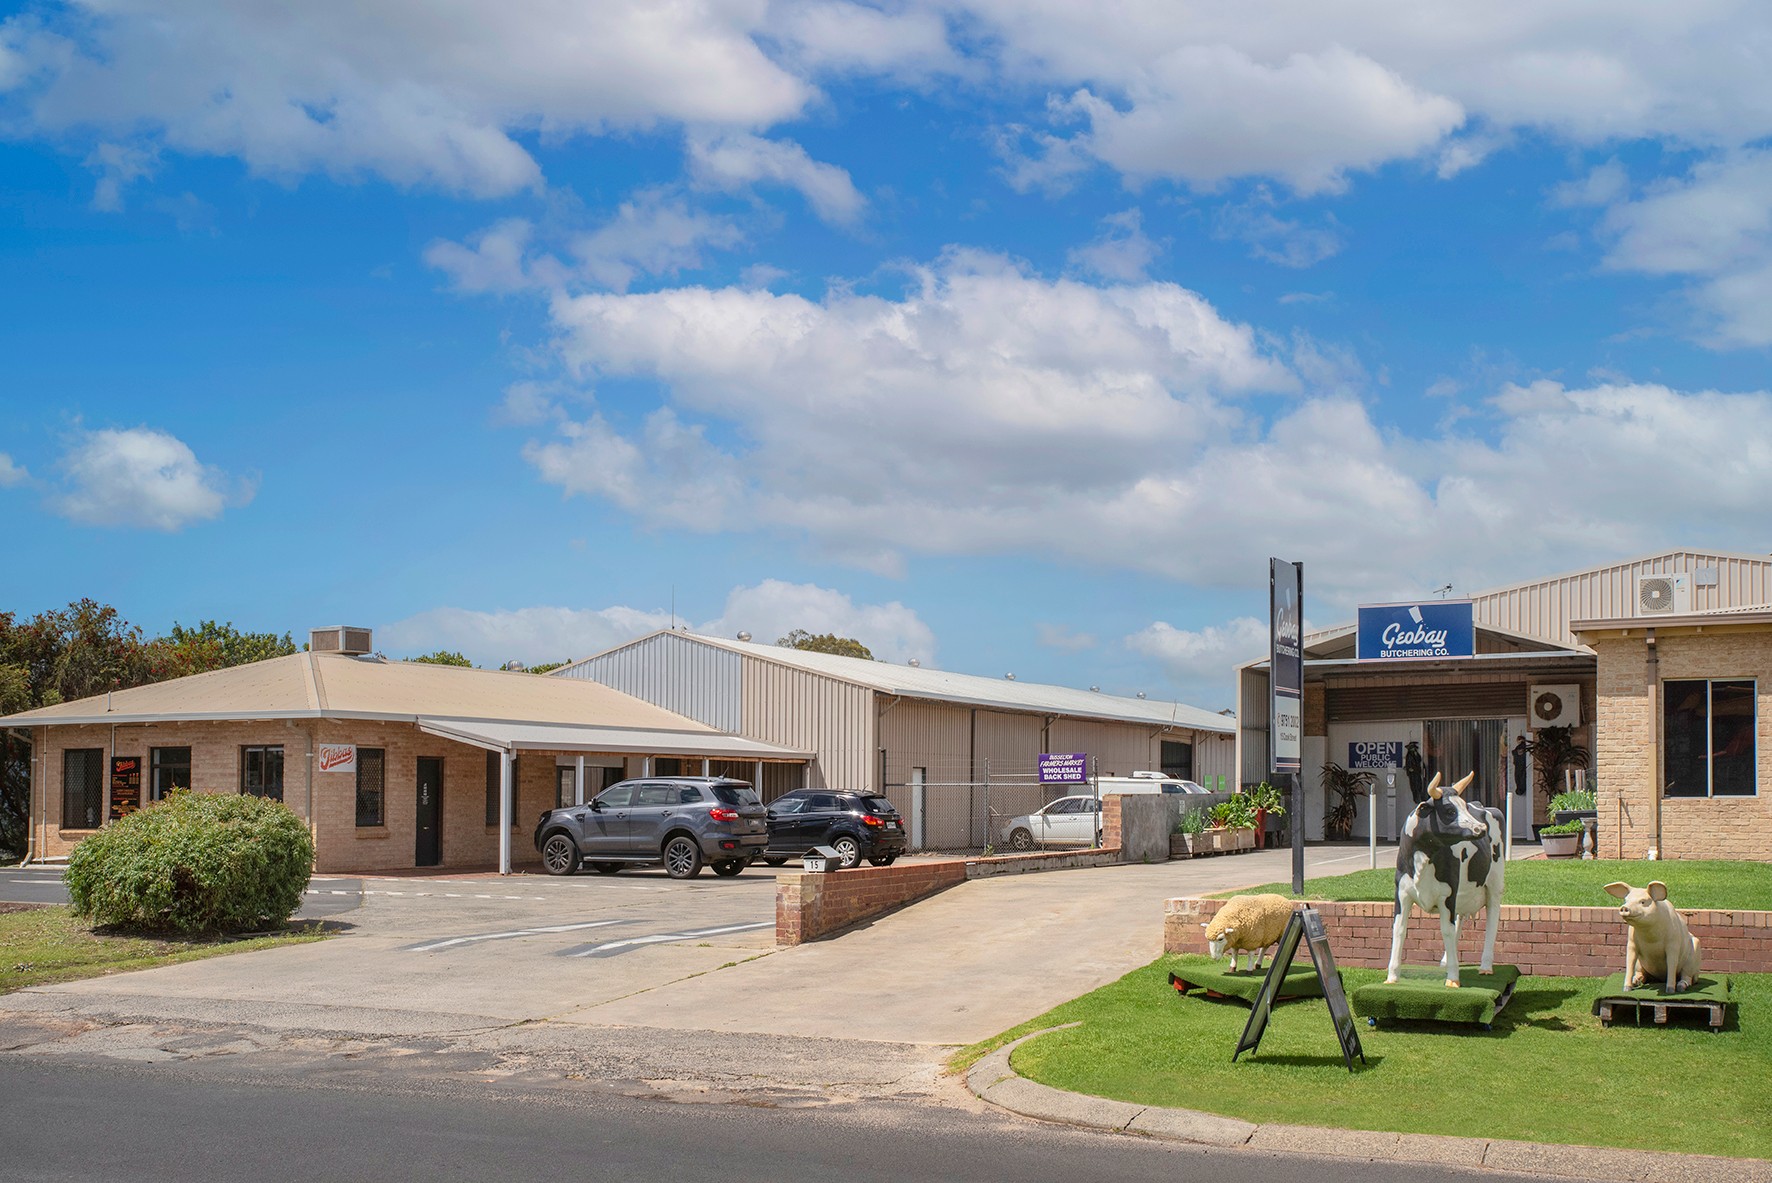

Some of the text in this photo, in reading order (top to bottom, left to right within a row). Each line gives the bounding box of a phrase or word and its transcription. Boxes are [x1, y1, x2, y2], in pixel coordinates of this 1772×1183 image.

[1276, 607, 1299, 647] Geobay
[1382, 623, 1448, 650] Geobay
[1380, 648, 1449, 658] BUTCHERING CO.
[1355, 742, 1396, 755] OPEN
[810, 860, 819, 869] 15
